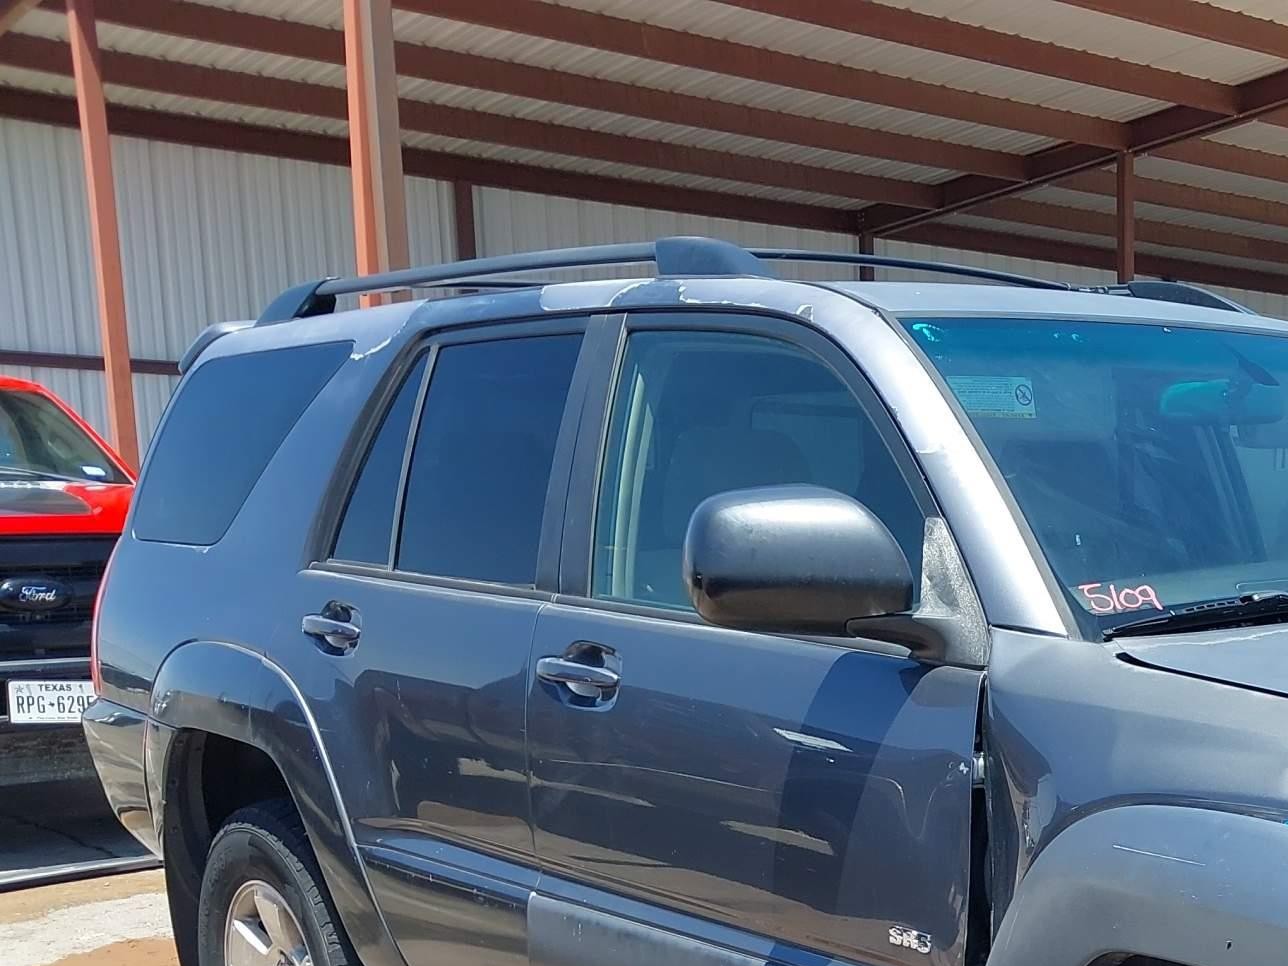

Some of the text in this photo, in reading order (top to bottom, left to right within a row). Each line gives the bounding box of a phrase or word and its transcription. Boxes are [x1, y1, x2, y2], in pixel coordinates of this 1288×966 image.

[19, 586, 56, 602] Ford
[38, 683, 72, 692] TEXAS
[888, 926, 931, 953] SR5
